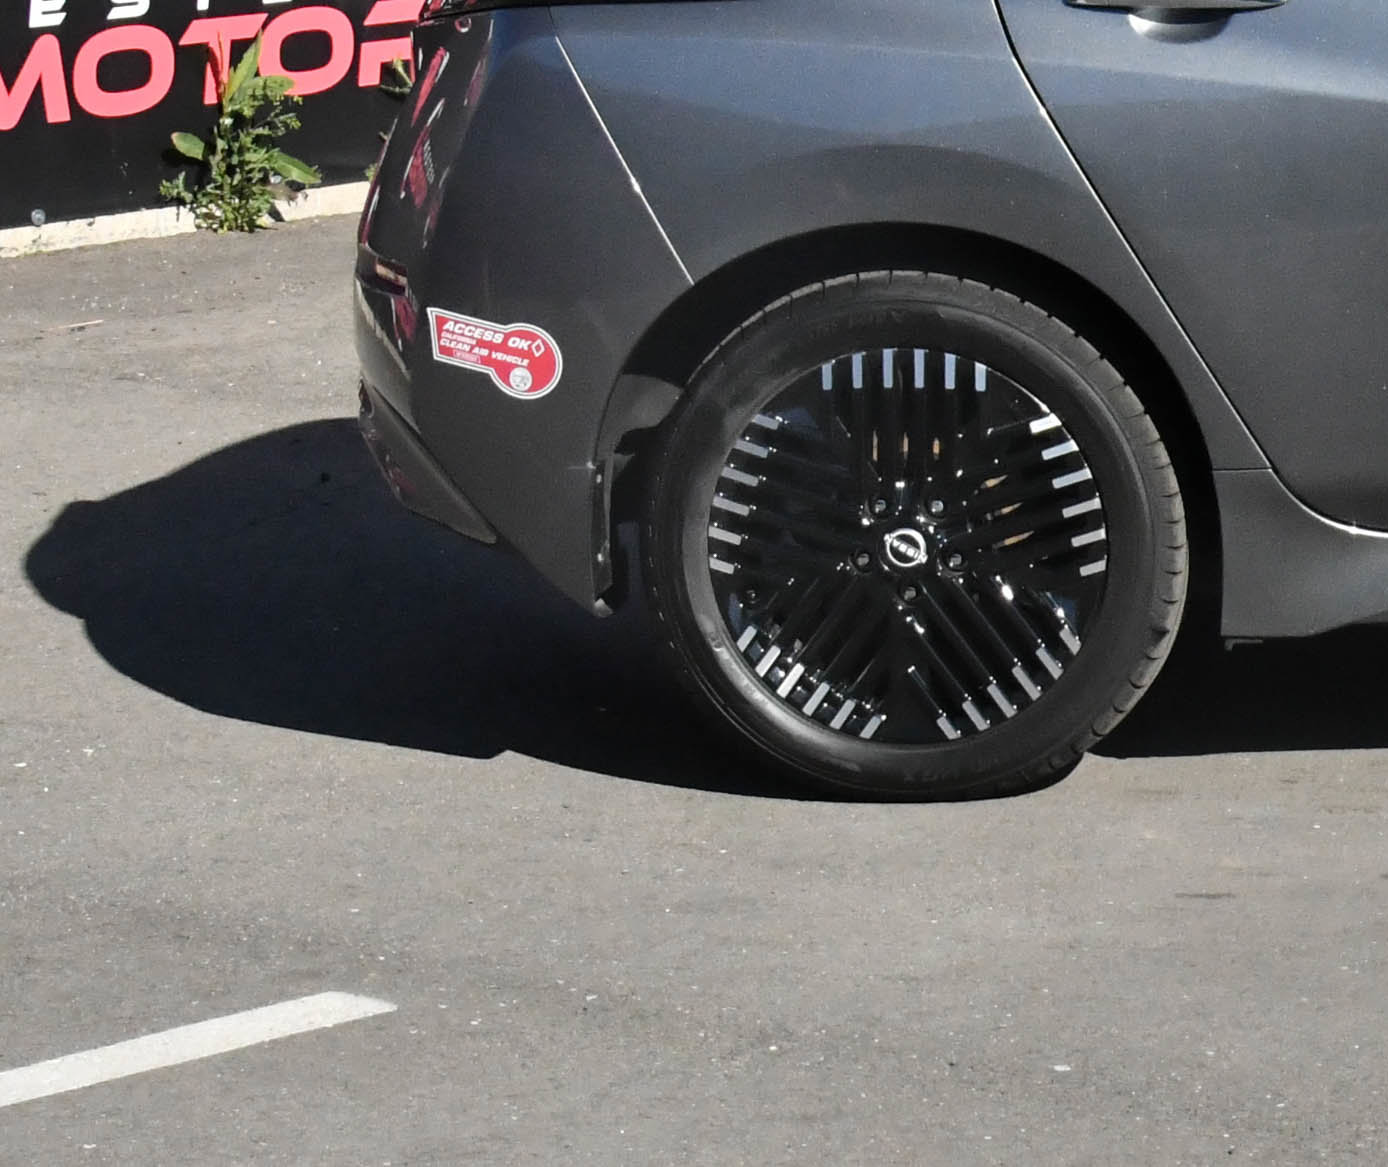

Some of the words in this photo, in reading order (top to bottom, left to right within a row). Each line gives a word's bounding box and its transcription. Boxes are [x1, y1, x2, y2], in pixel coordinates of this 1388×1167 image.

[442, 320, 505, 344] ACCESS
[507, 336, 532, 351] OK
[440, 338, 470, 353] CLEAN
[471, 346, 489, 357] AIR
[491, 351, 530, 367] VEHICLE
